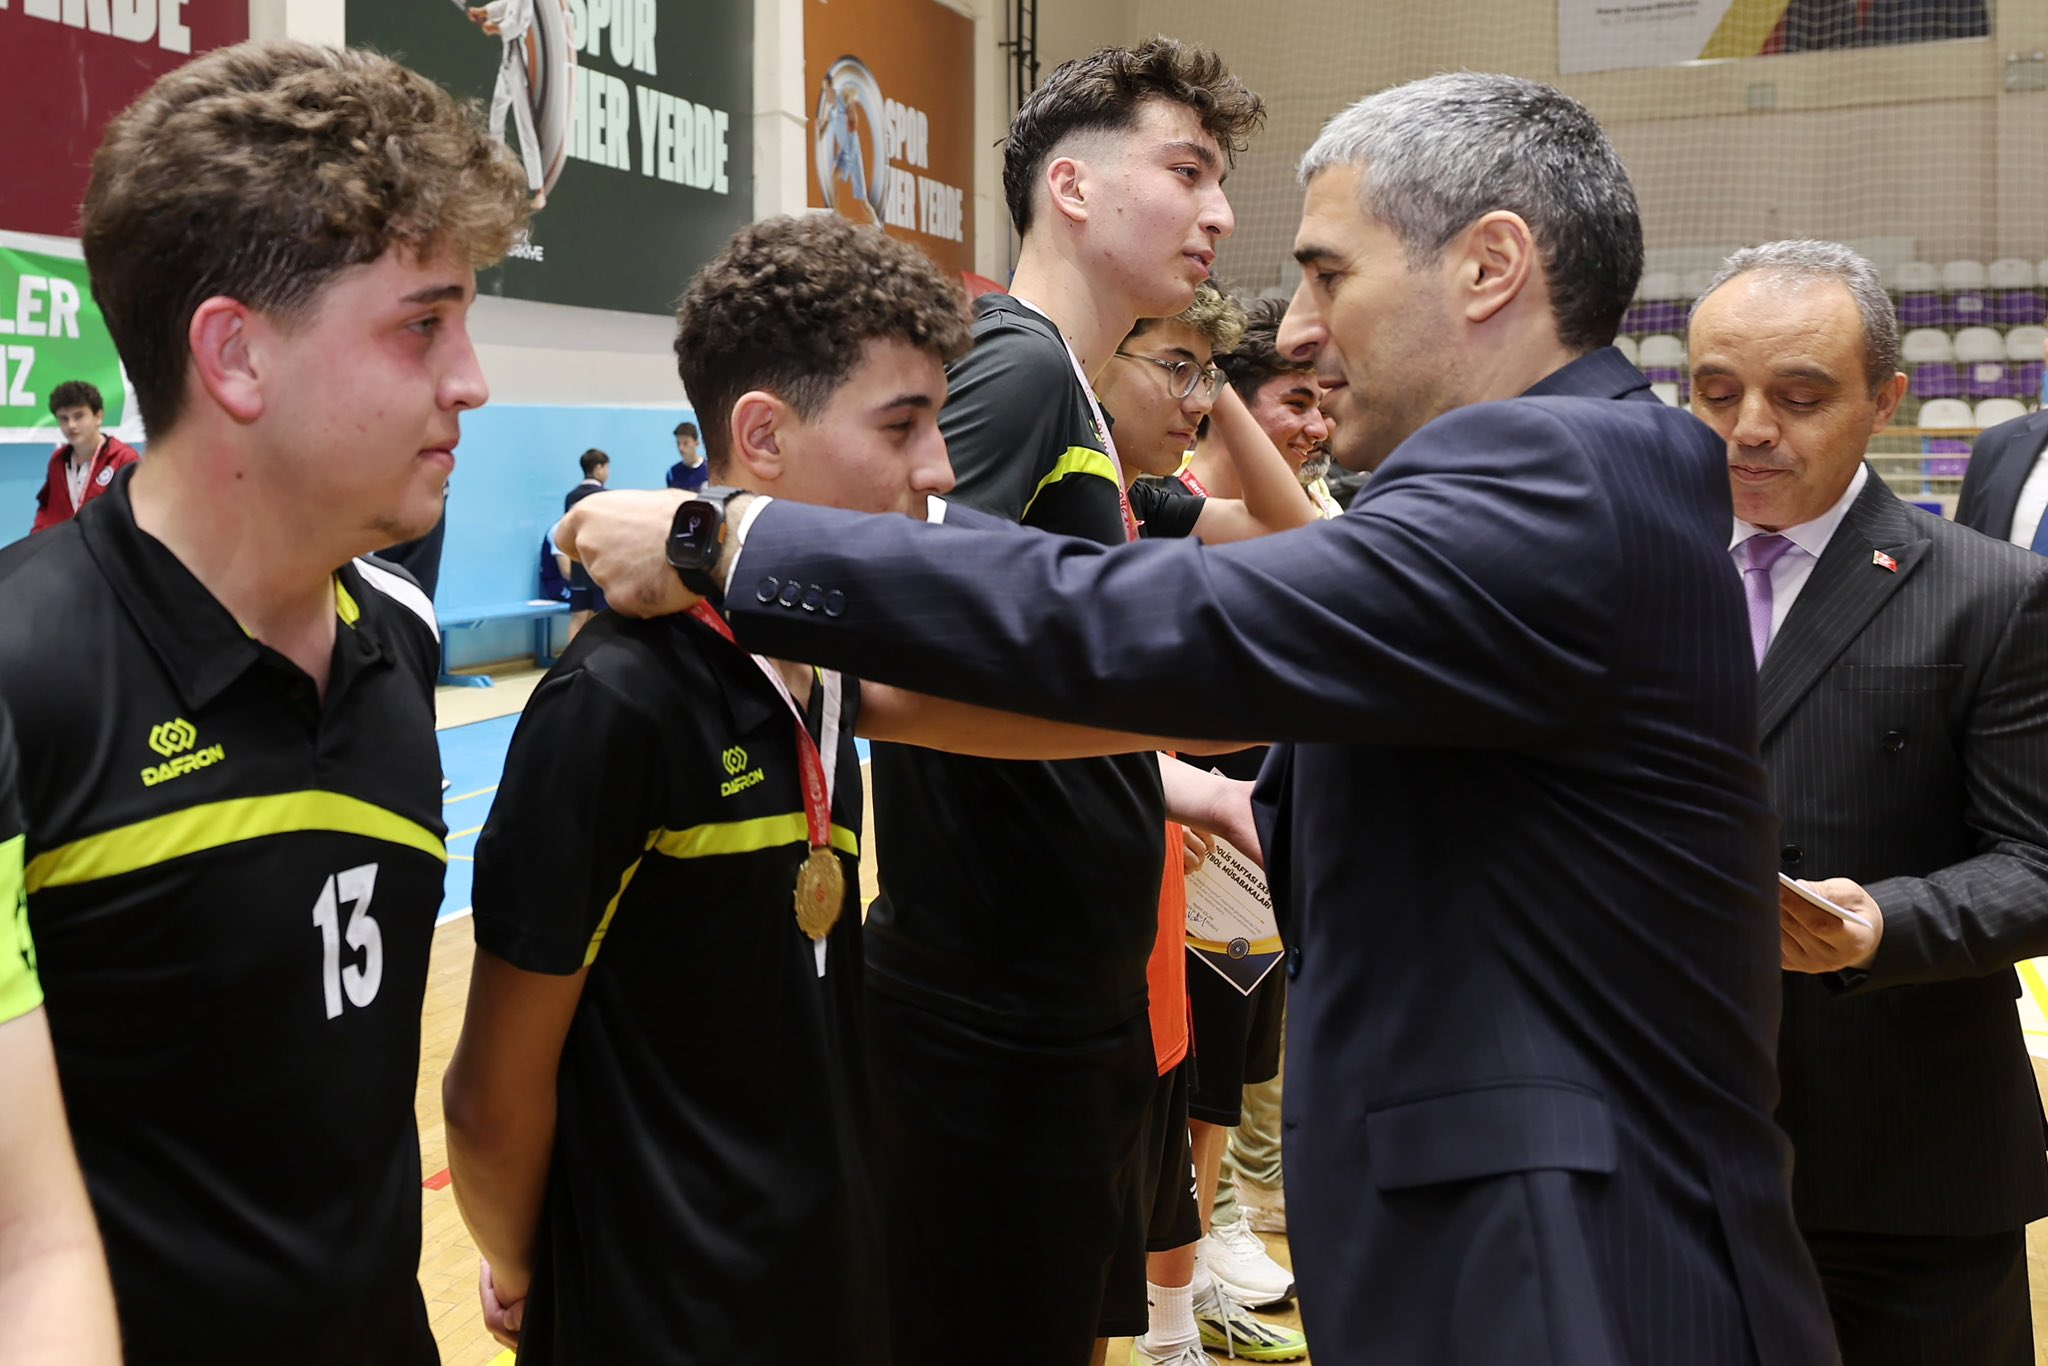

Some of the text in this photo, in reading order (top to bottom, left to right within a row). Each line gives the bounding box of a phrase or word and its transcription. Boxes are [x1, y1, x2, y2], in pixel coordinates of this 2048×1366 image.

[566, 64, 729, 195] HER YERDE
[885, 98, 929, 170] SPOR
[884, 165, 964, 243] HER YERDE
[140, 743, 225, 787] DAFRON
[721, 768, 764, 797] DAFRON
[1205, 850, 1224, 869] TBOL
[1221, 865, 1272, 910] MÜSABAKALARI
[1230, 859, 1259, 885] HAFTASI
[312, 862, 383, 1020] 13
